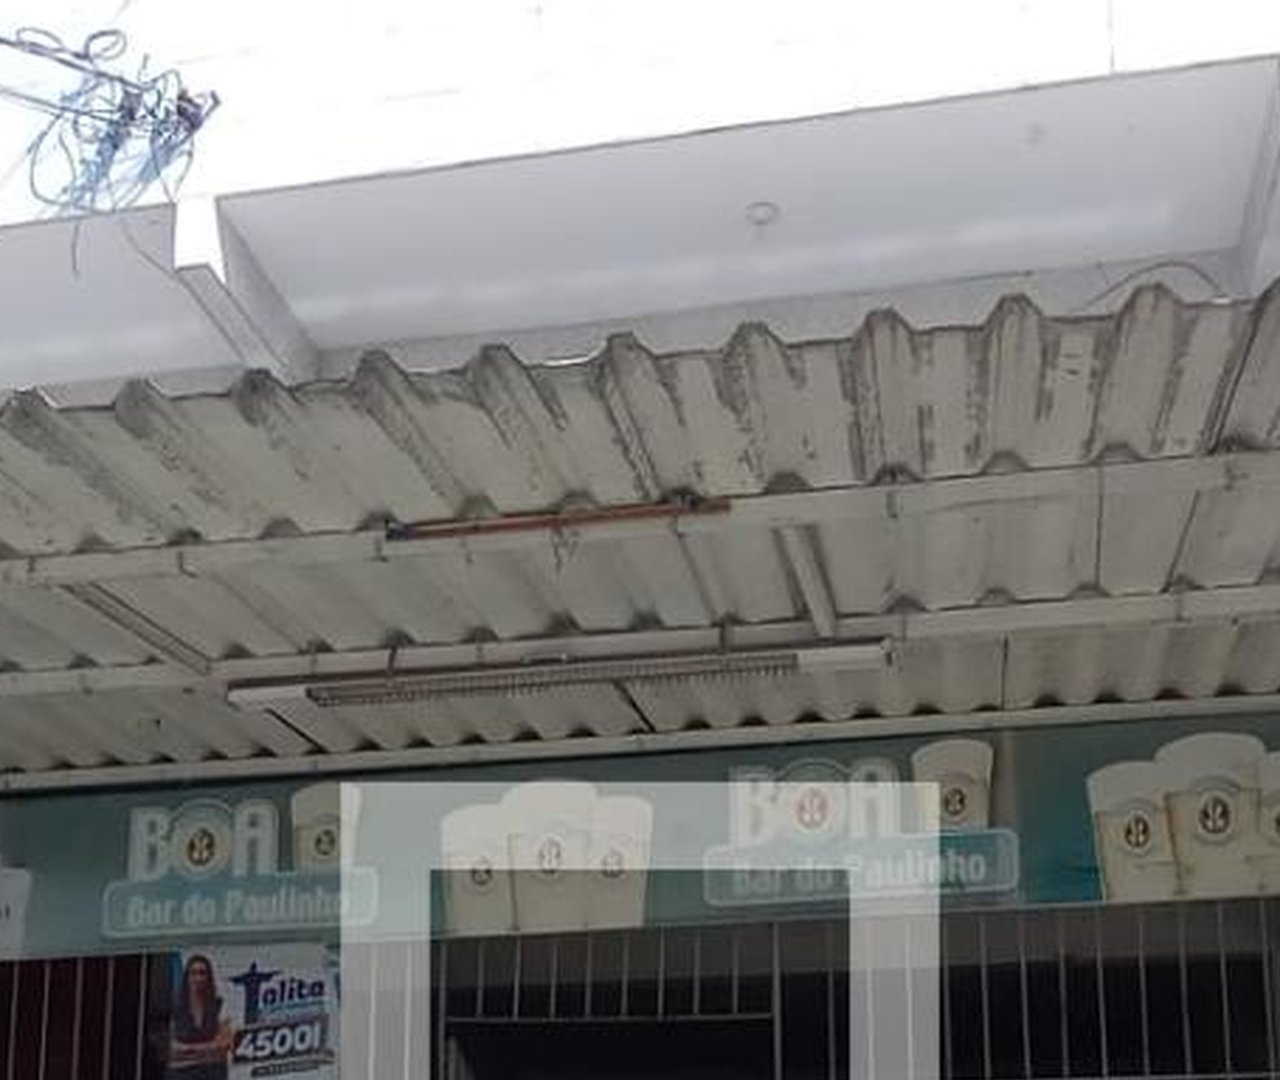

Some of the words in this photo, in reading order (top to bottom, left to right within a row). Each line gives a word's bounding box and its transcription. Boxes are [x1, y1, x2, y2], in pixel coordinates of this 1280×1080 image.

[128, 800, 279, 881] BOA
[732, 861, 780, 894] Bar
[799, 857, 834, 892] do
[850, 850, 986, 889] Paulinho
[126, 896, 176, 927] Bar
[182, 893, 216, 925] do
